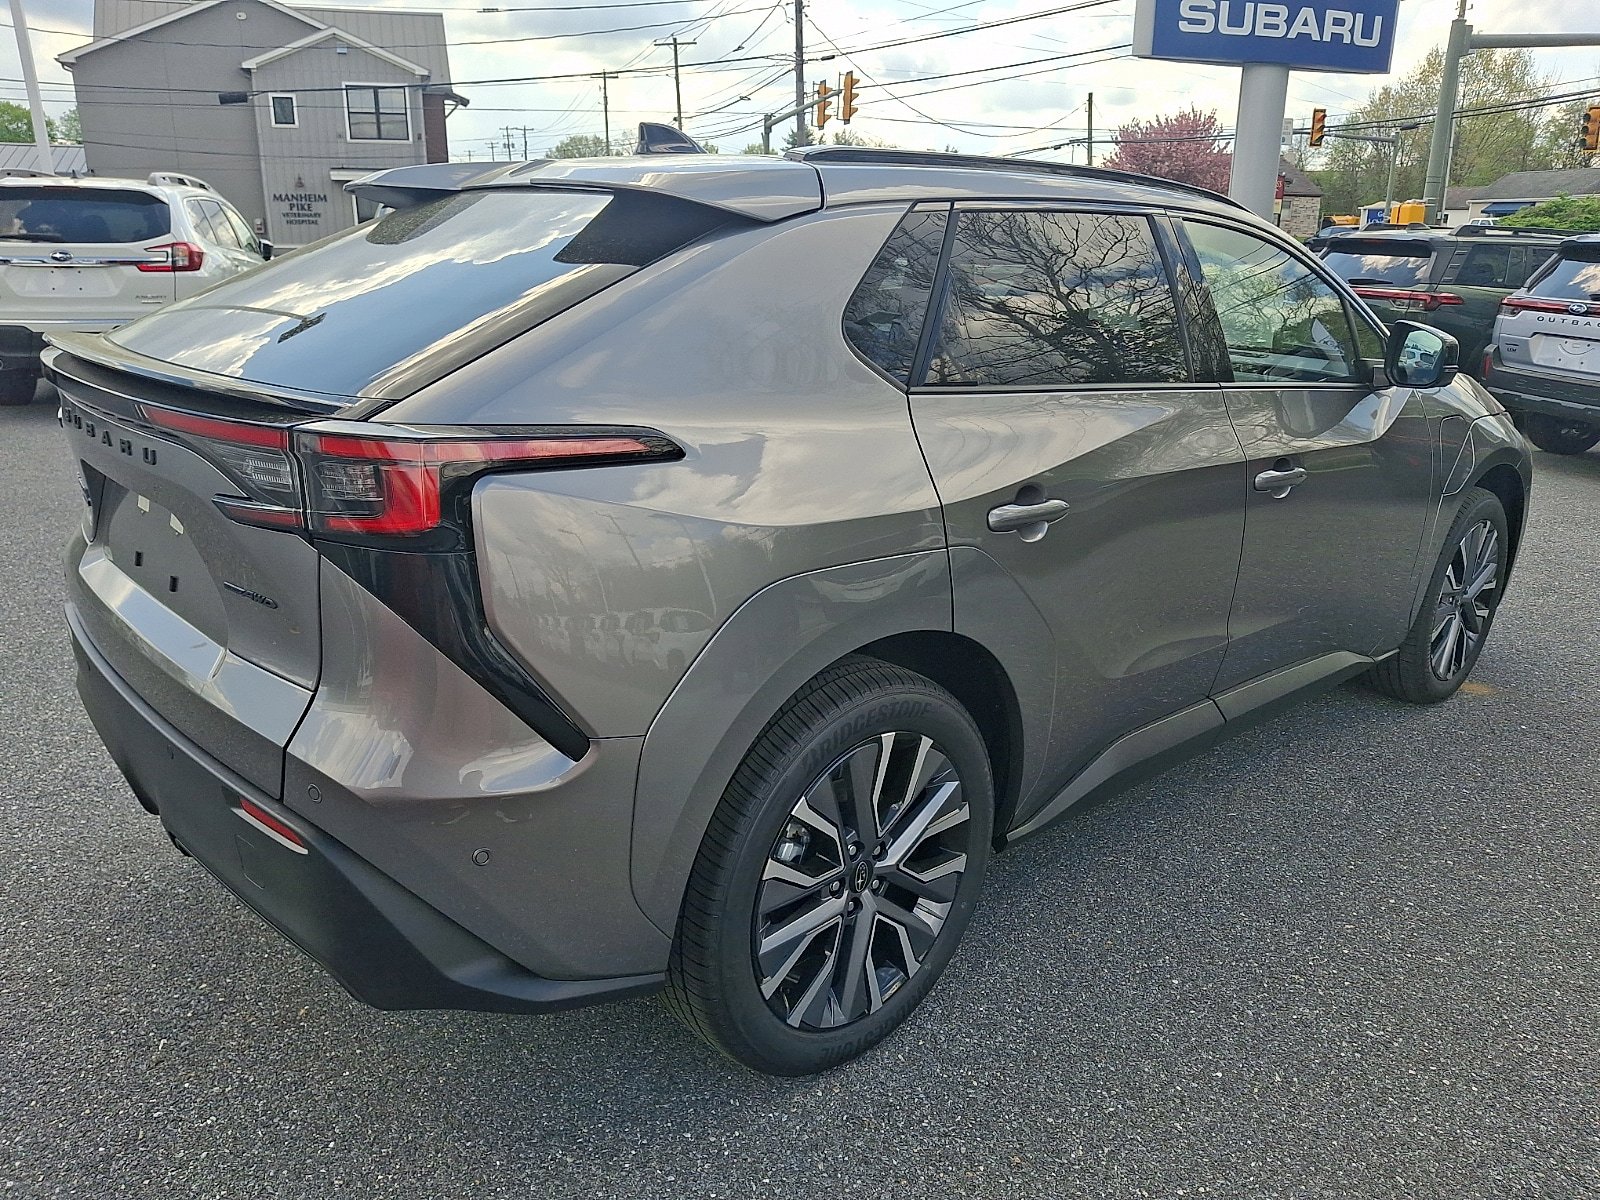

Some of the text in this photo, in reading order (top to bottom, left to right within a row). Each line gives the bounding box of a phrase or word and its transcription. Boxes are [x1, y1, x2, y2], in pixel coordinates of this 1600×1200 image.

[1178, 0, 1383, 47] SUBARU
[273, 193, 327, 202] MANHEIM
[289, 203, 313, 211] PIKE
[64, 407, 158, 465] SUBARU
